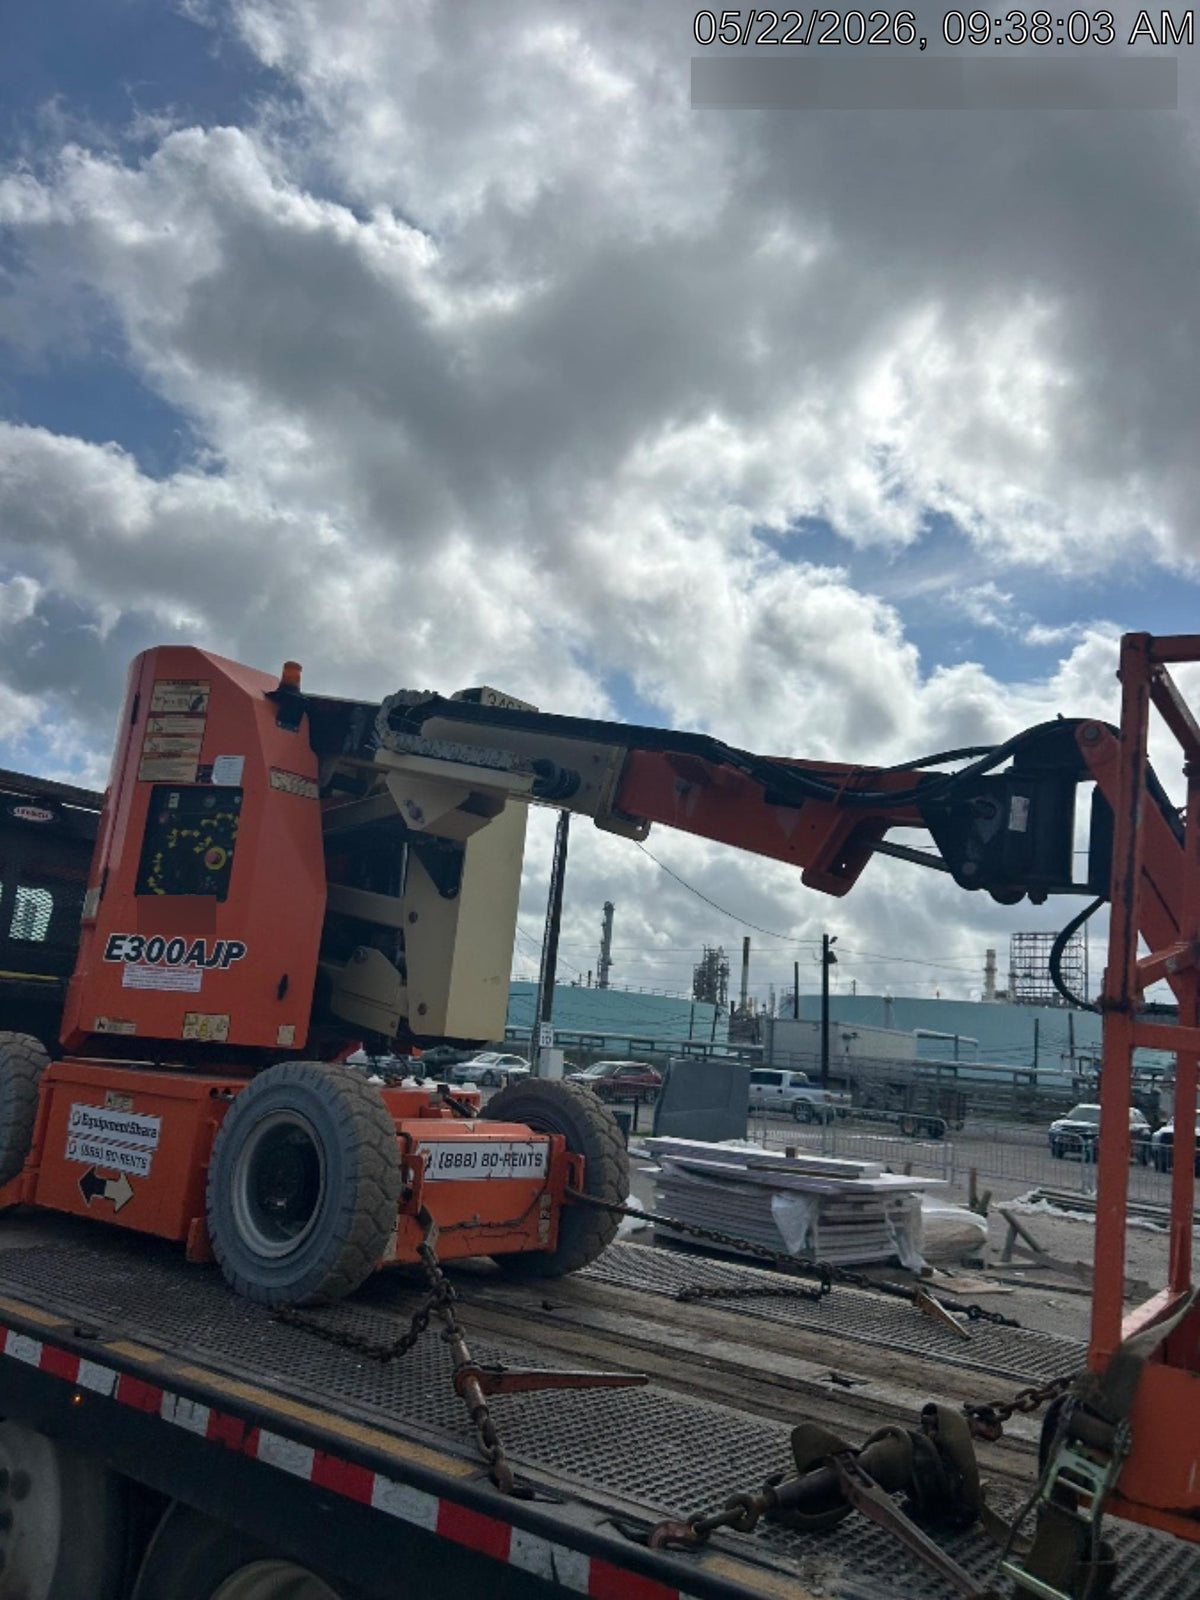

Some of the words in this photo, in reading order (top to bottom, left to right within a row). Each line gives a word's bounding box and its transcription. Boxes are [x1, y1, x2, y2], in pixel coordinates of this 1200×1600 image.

[103, 933, 247, 969] E300AJP
[438, 1151, 477, 1169] (888)
[481, 1152, 544, 1167] 80-RENTS
